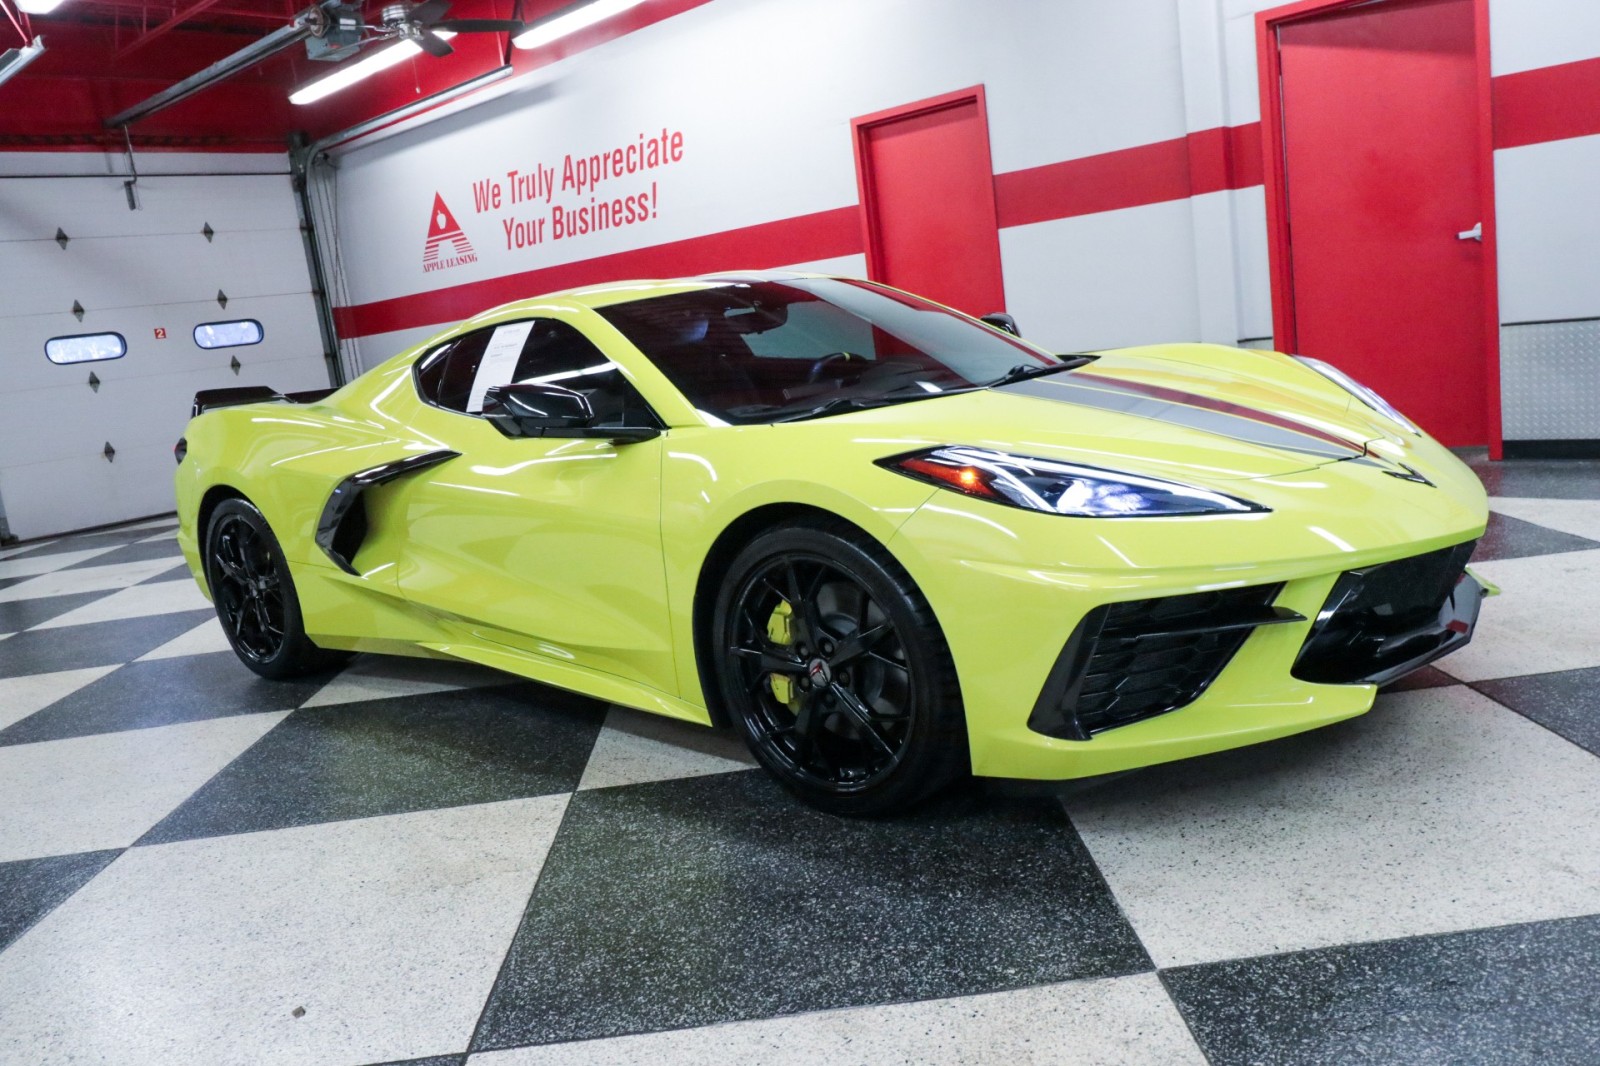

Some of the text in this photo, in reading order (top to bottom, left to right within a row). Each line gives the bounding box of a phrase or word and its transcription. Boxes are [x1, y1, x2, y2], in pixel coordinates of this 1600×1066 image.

[472, 127, 684, 213] We Truly Appreciate
[503, 181, 658, 250] Your Business!
[423, 253, 478, 273] APPLE LEASING
[156, 328, 165, 339] 2
